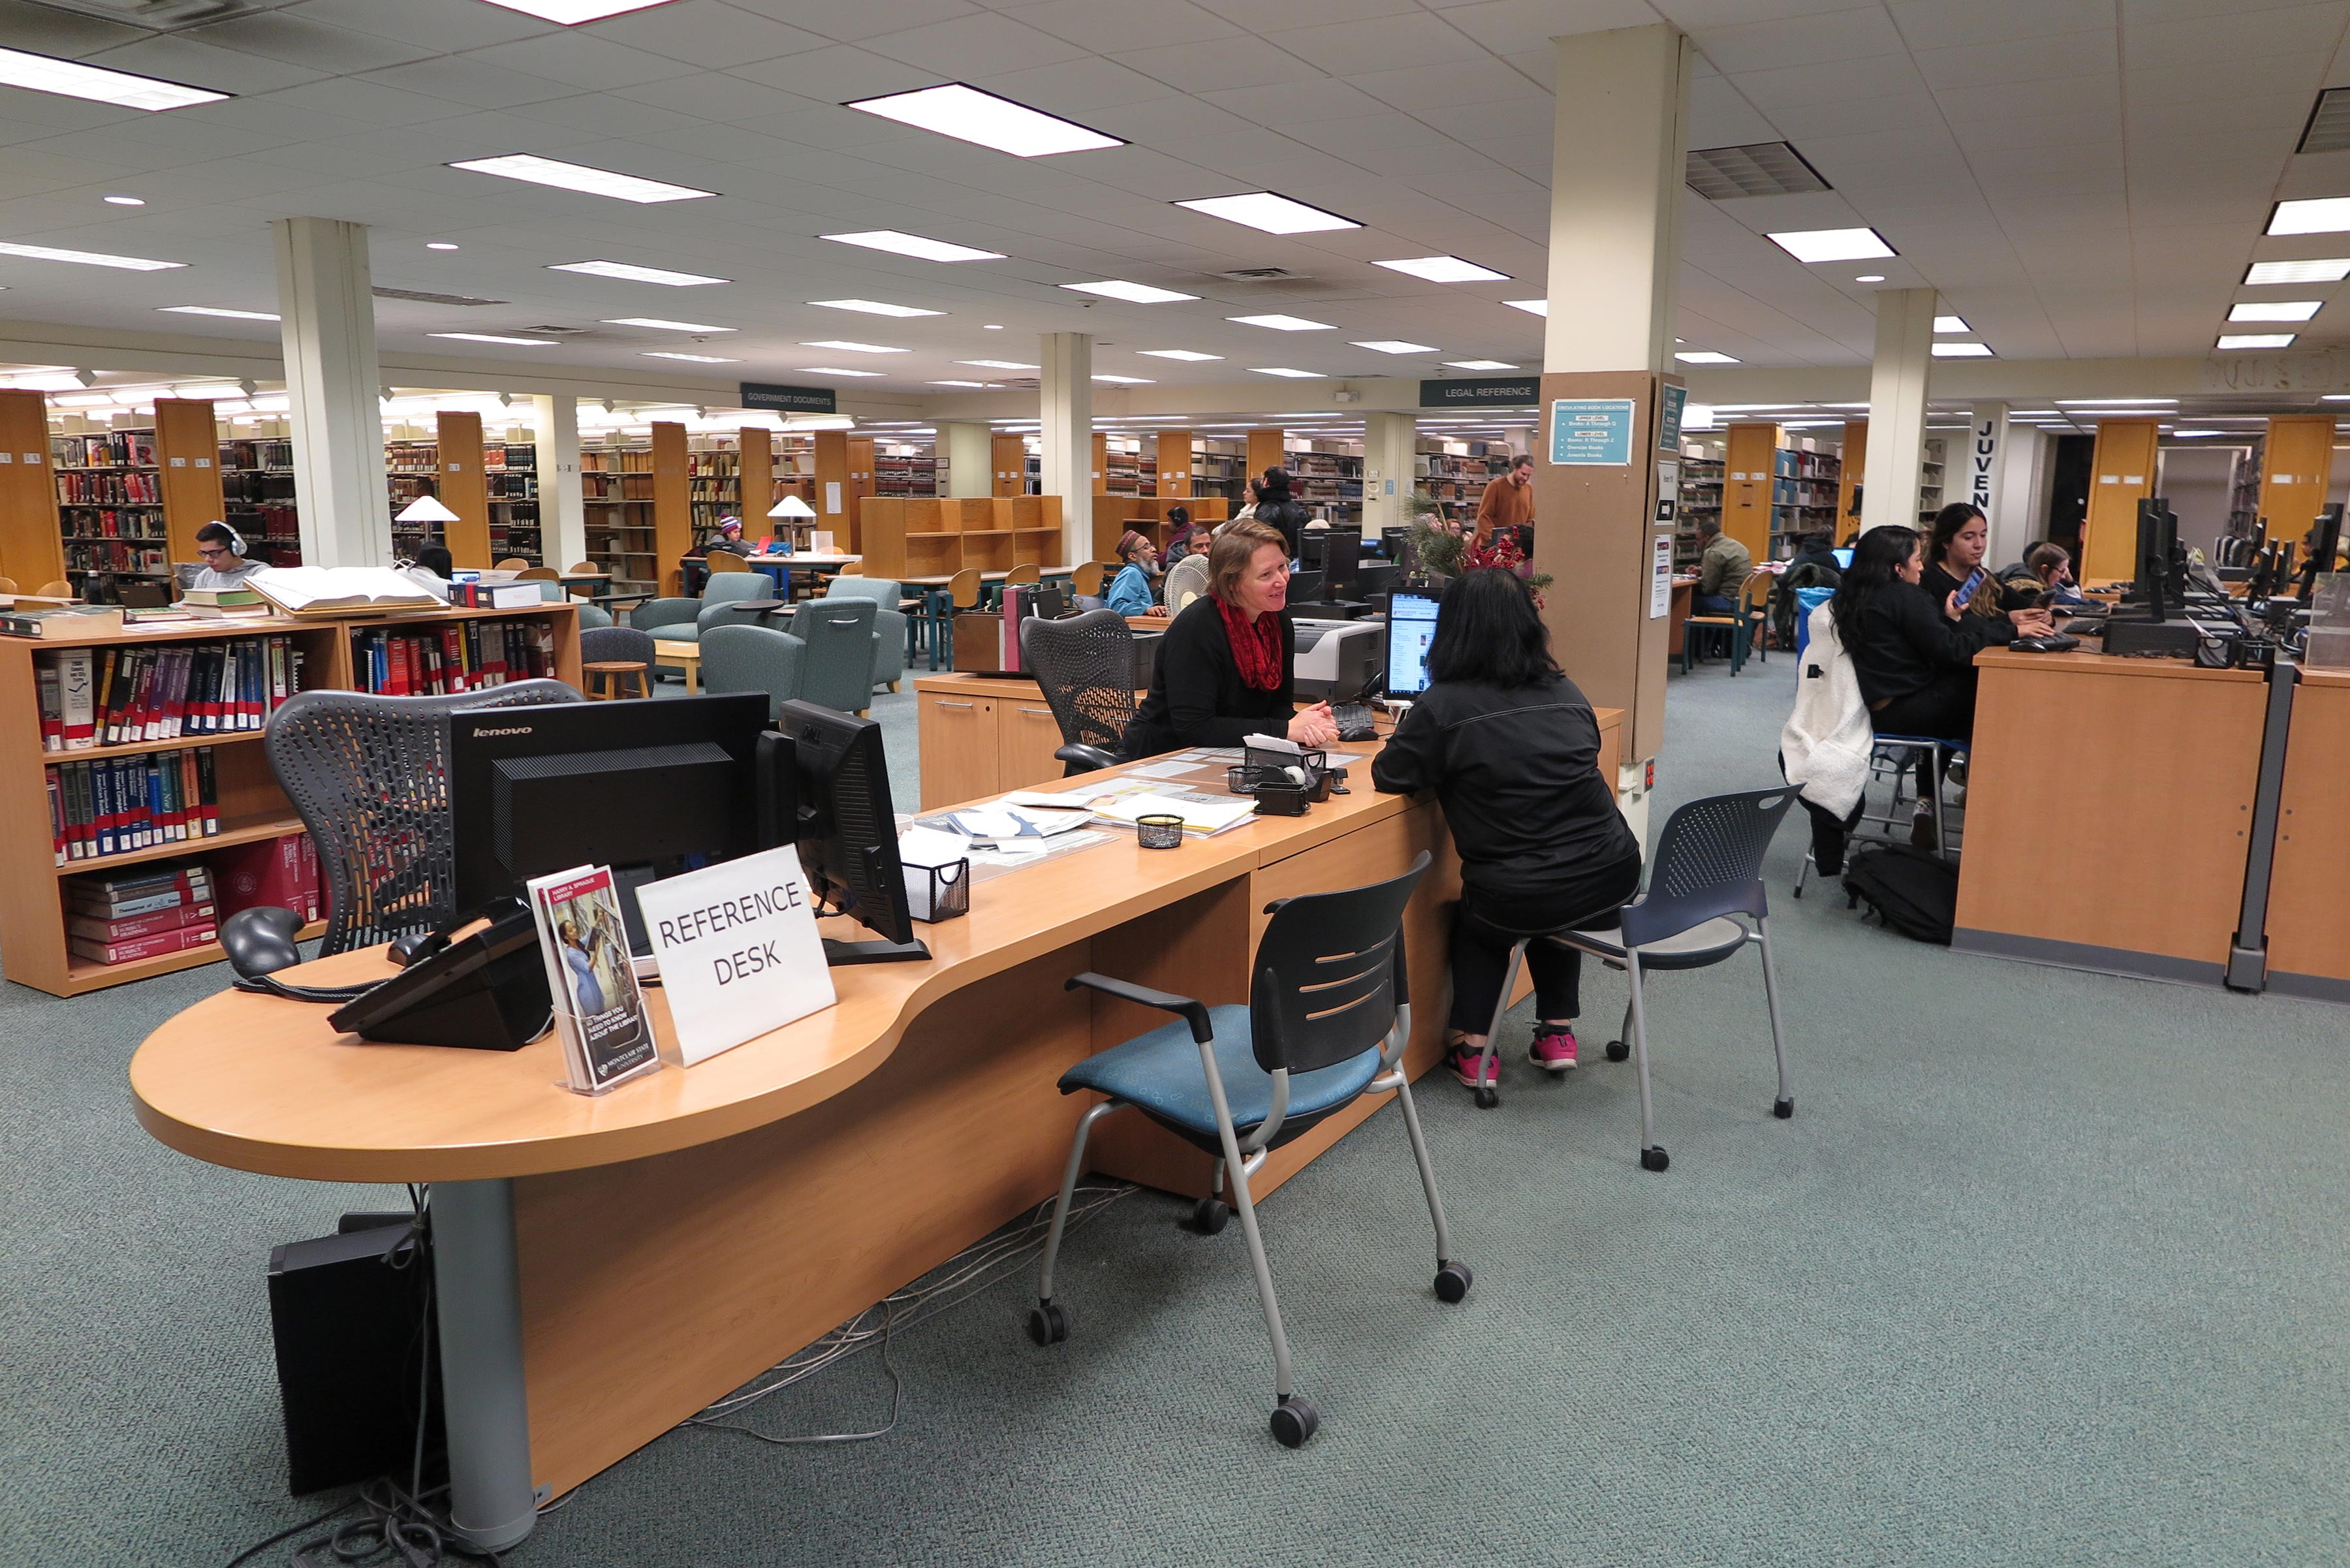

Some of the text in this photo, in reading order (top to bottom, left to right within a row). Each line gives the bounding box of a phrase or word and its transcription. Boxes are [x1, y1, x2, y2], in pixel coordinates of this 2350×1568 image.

[747, 392, 831, 405] GOVERNMENT DOCUMENTS
[1445, 386, 1531, 397] LEGAL REFERENCE
[473, 727, 533, 737] lenovo
[552, 886, 568, 896] HARRY
[573, 877, 595, 889] SPRAGUE
[553, 890, 574, 902] LIBRARY
[659, 882, 802, 948] REFERENCE
[119, 924, 141, 932] SUBJECT
[119, 928, 148, 937] HEADINGS
[119, 950, 148, 960] HEADINGS
[713, 940, 781, 986] DESK
[593, 1010, 613, 1022] THINGS
[612, 1005, 624, 1014] YOU
[588, 1011, 627, 1034] NEED TO KNOW
[589, 1028, 609, 1041] ABOUT
[608, 1024, 619, 1033] THE
[607, 1043, 650, 1067] MONTCLAIR STATE
[617, 1054, 644, 1071] UNIVERSITY
